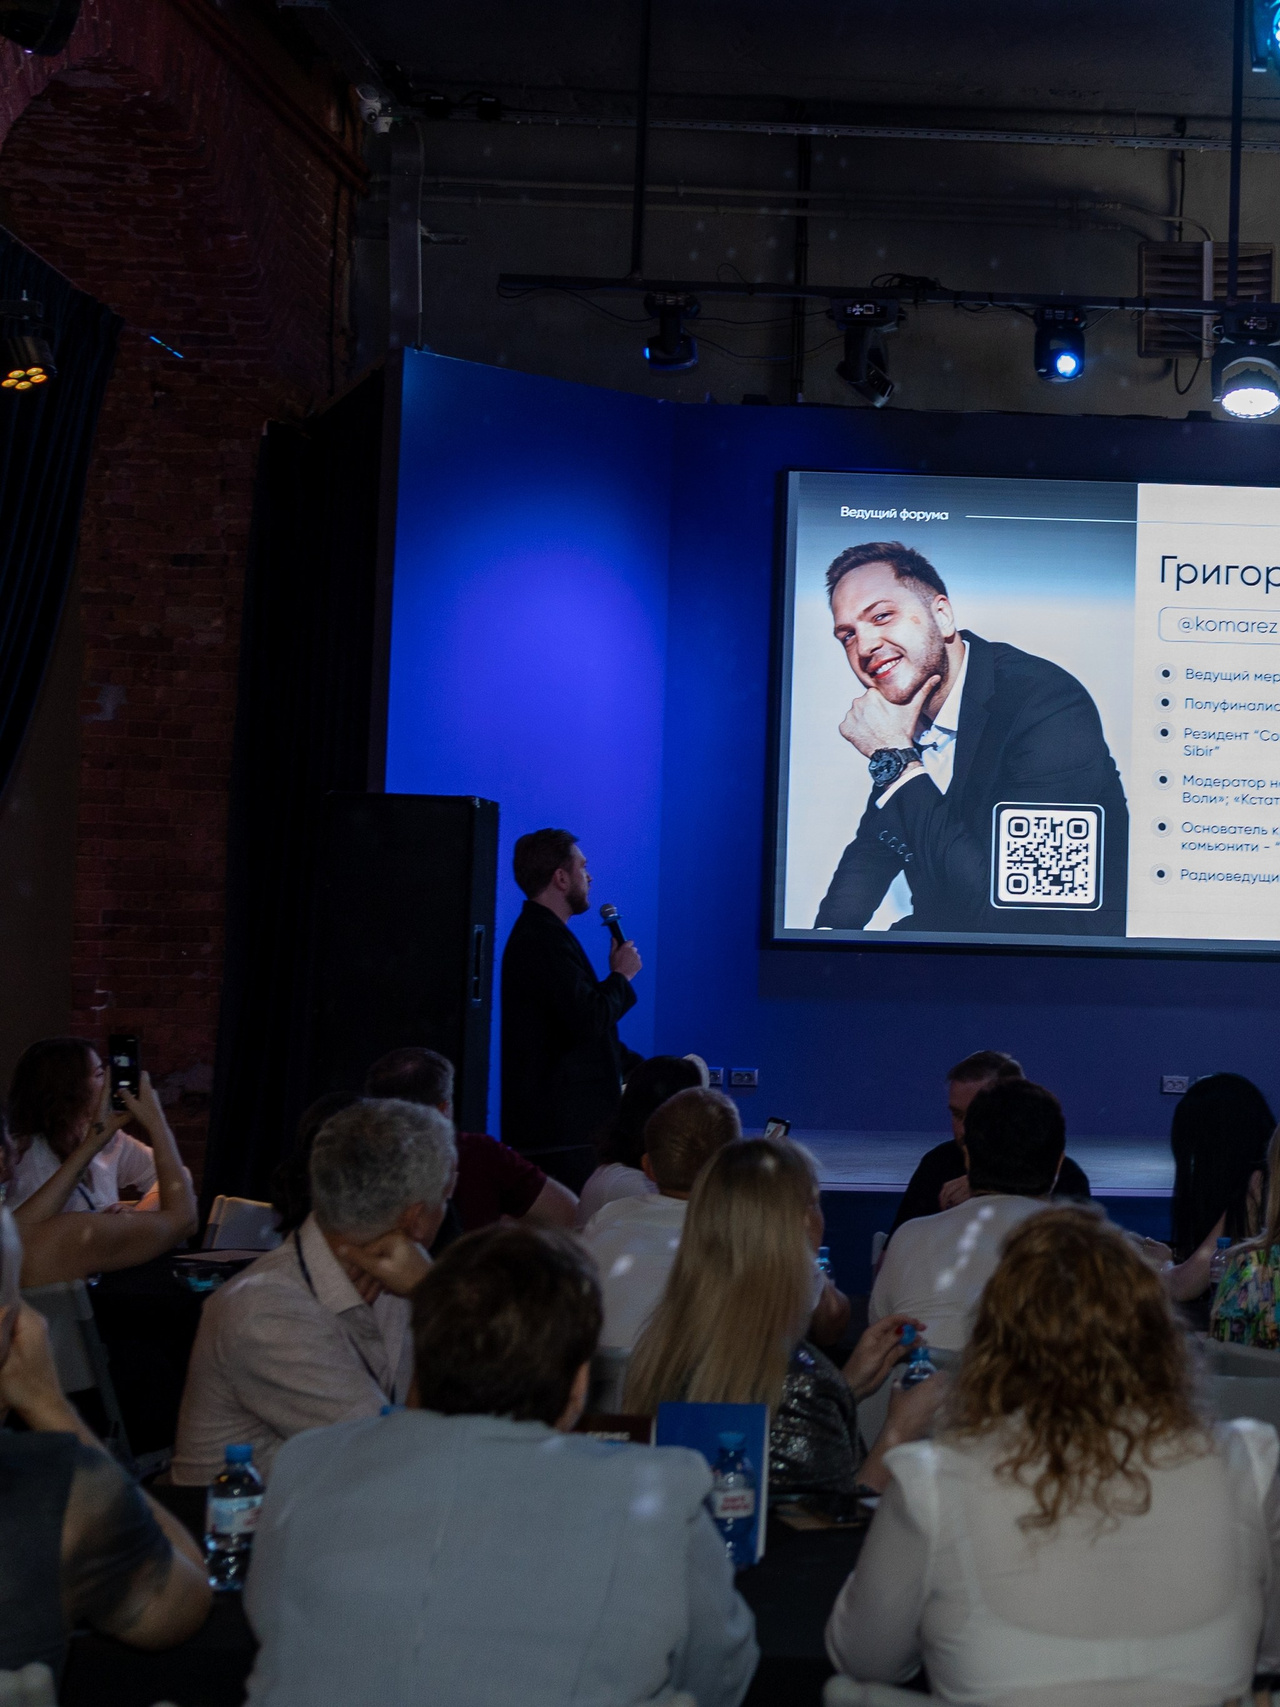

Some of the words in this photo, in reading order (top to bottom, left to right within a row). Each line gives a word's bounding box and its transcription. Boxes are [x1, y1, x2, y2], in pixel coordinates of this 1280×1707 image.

[840, 505, 898, 521] Ведущий
[899, 508, 950, 523] форума
[1177, 616, 1278, 635] @komarez
[1185, 668, 1250, 683] Ведущий
[1183, 727, 1250, 742] Резидент
[1182, 774, 1266, 789] Модератор
[1181, 792, 1230, 806] Воли»;
[1181, 821, 1268, 835] Основатель
[1180, 840, 1259, 853] комьюнити
